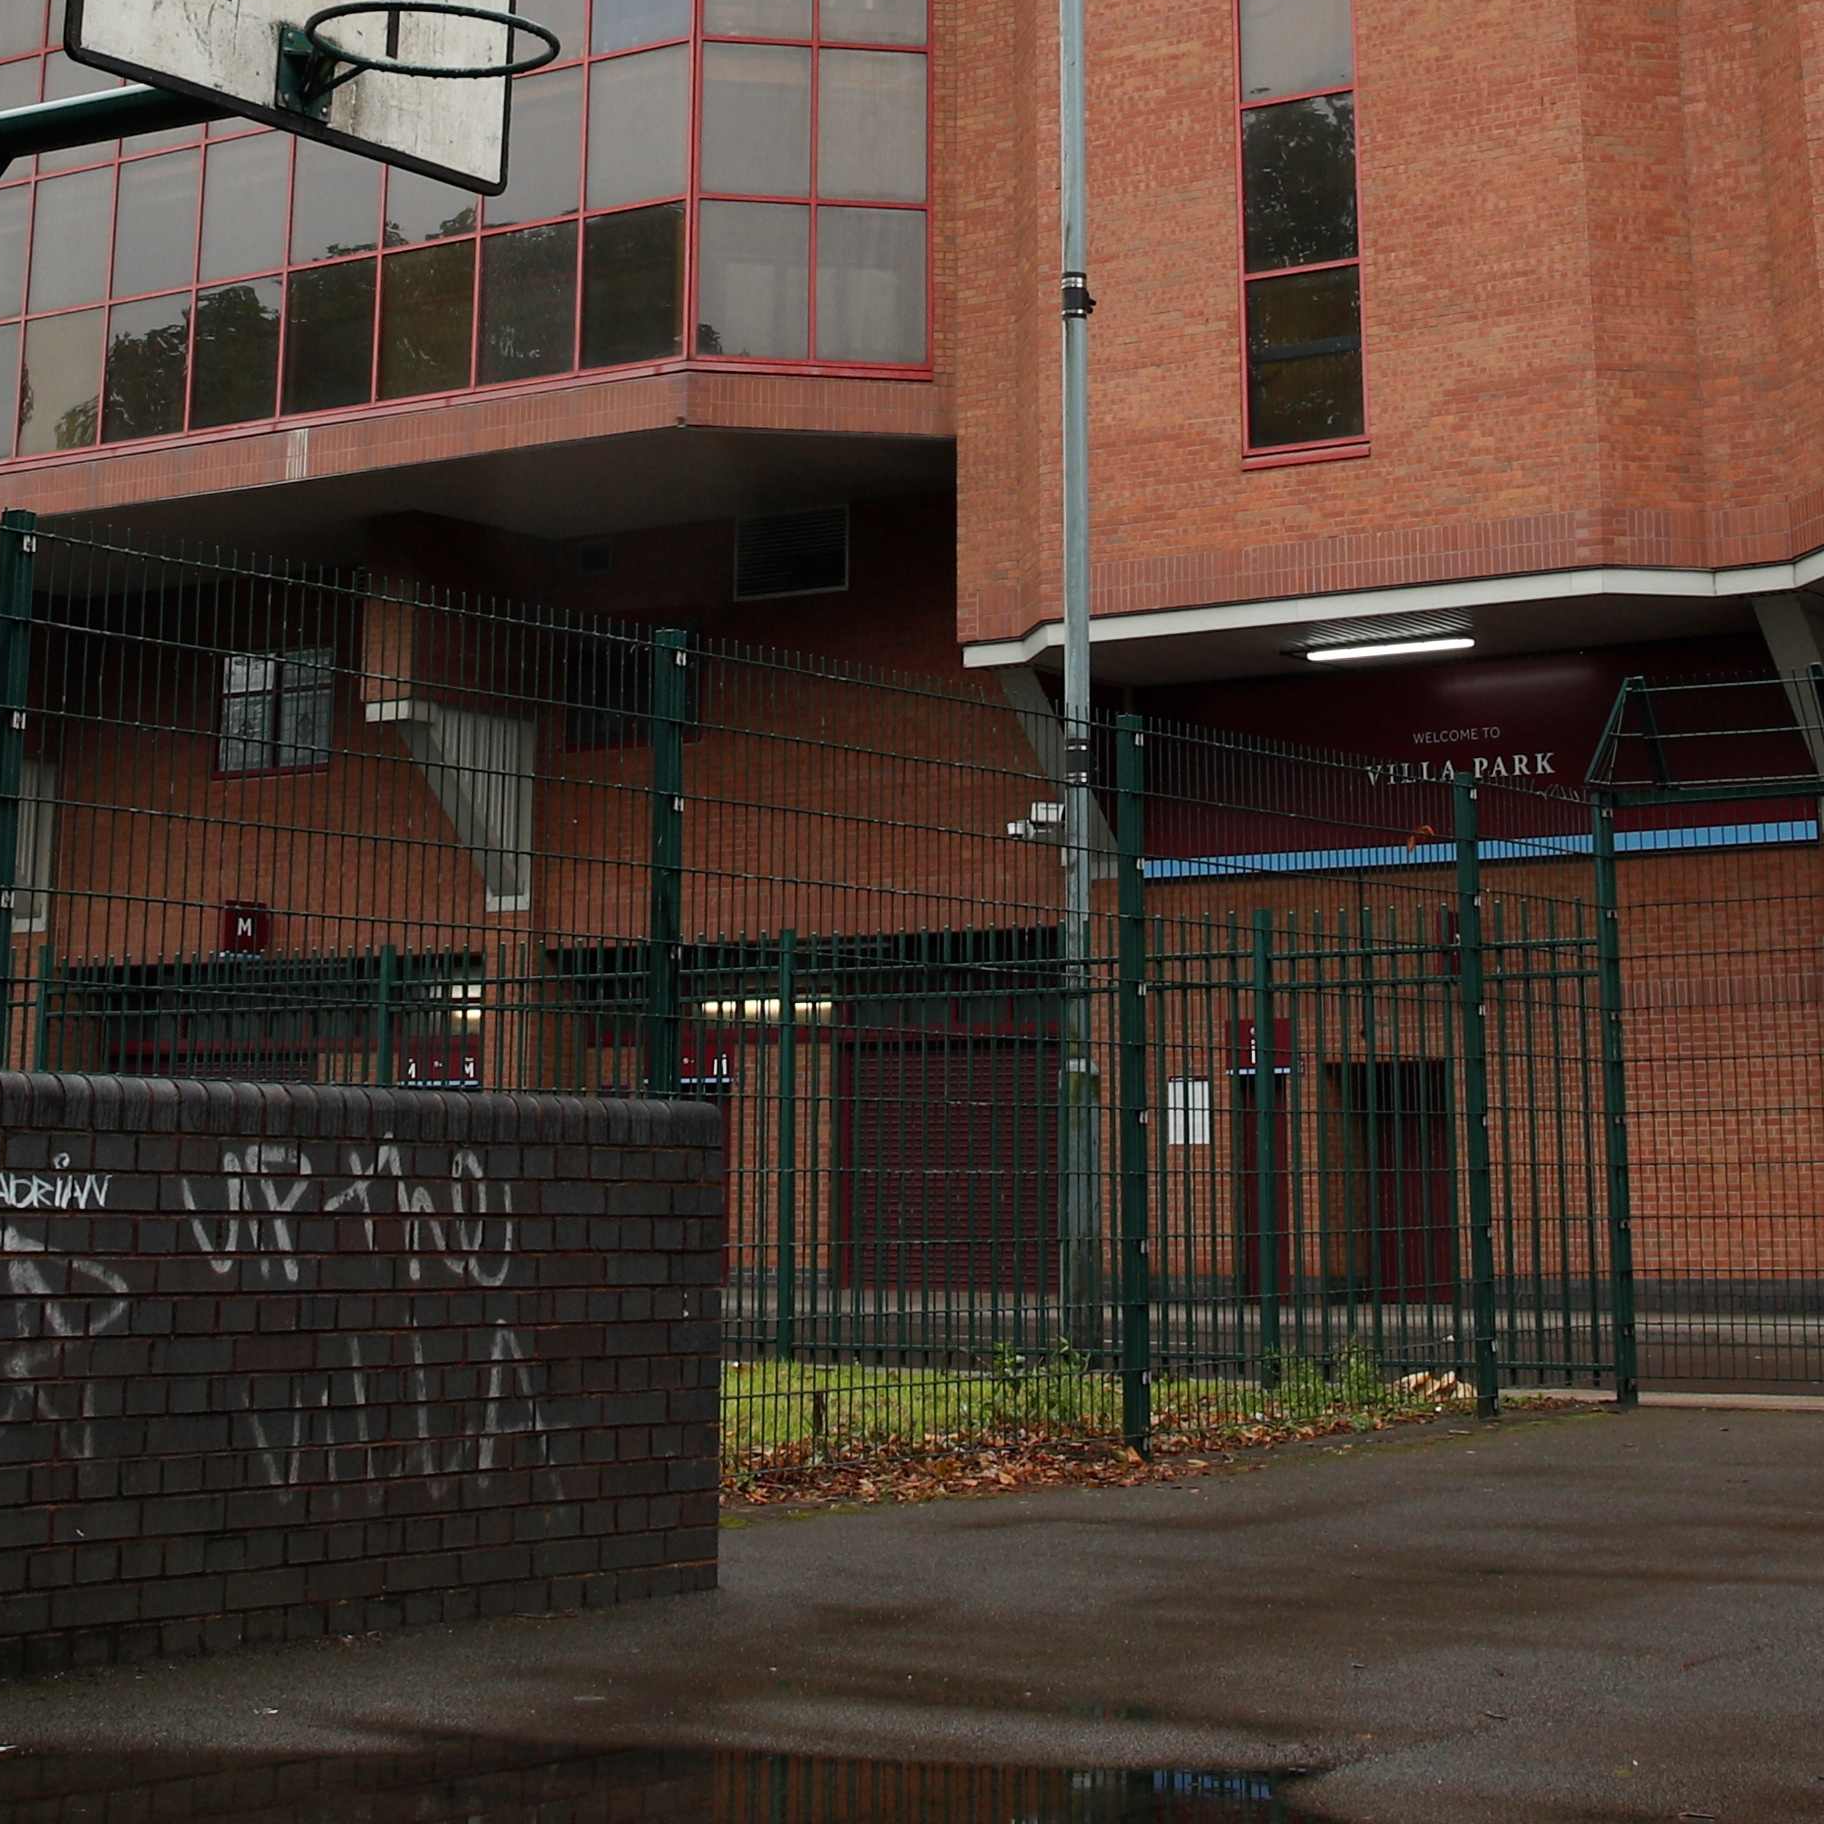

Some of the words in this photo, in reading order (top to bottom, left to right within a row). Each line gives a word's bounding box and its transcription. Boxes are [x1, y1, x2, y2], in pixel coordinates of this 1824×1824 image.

[1412, 728, 1478, 745] WELCOME
[1482, 726, 1502, 739] TO
[1366, 760, 1456, 786] VILLA
[1473, 752, 1556, 778] PARK
[237, 917, 252, 937] M
